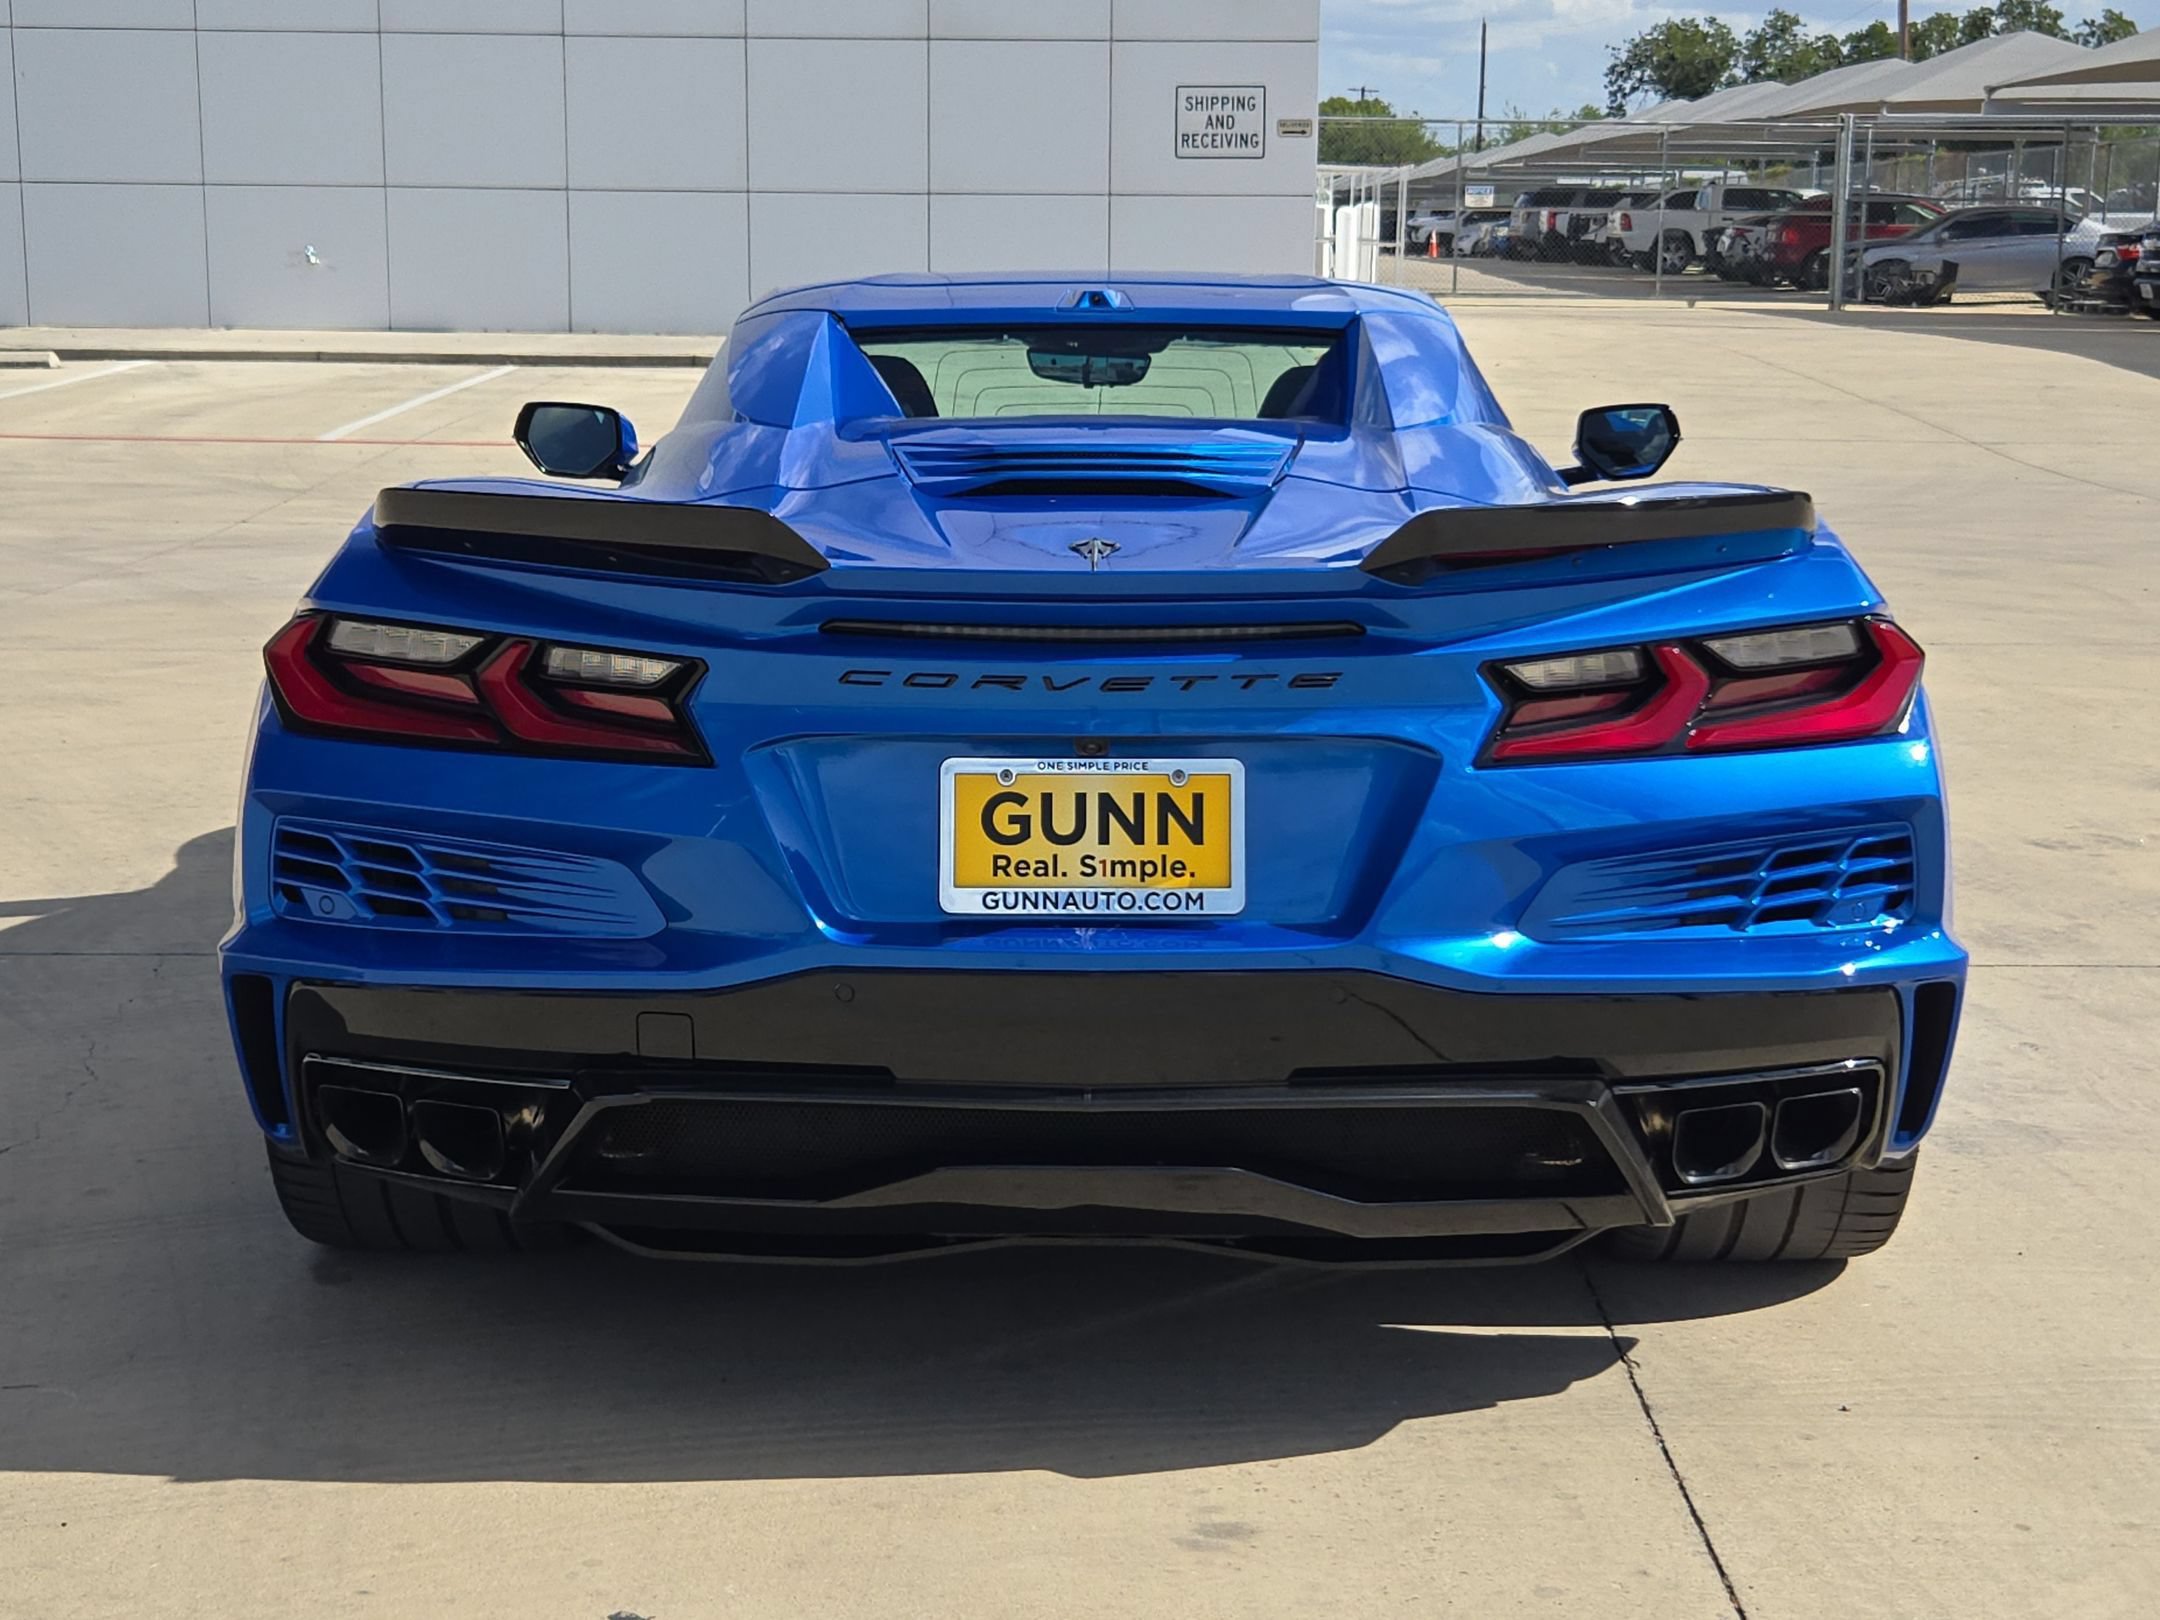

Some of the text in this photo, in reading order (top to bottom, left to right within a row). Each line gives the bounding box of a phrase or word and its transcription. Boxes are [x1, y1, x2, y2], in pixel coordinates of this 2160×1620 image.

[1184, 95, 1257, 112] SHIPPING
[1204, 114, 1236, 130] AND
[1181, 132, 1260, 149] RECEIVING
[837, 669, 1344, 693] CORVETTE
[1037, 760, 1150, 771] ONE SIMPLE PRICE
[980, 791, 1205, 846] GUNN
[992, 853, 1068, 878] Real.
[982, 891, 1205, 911] GUNNAUTO.COM
